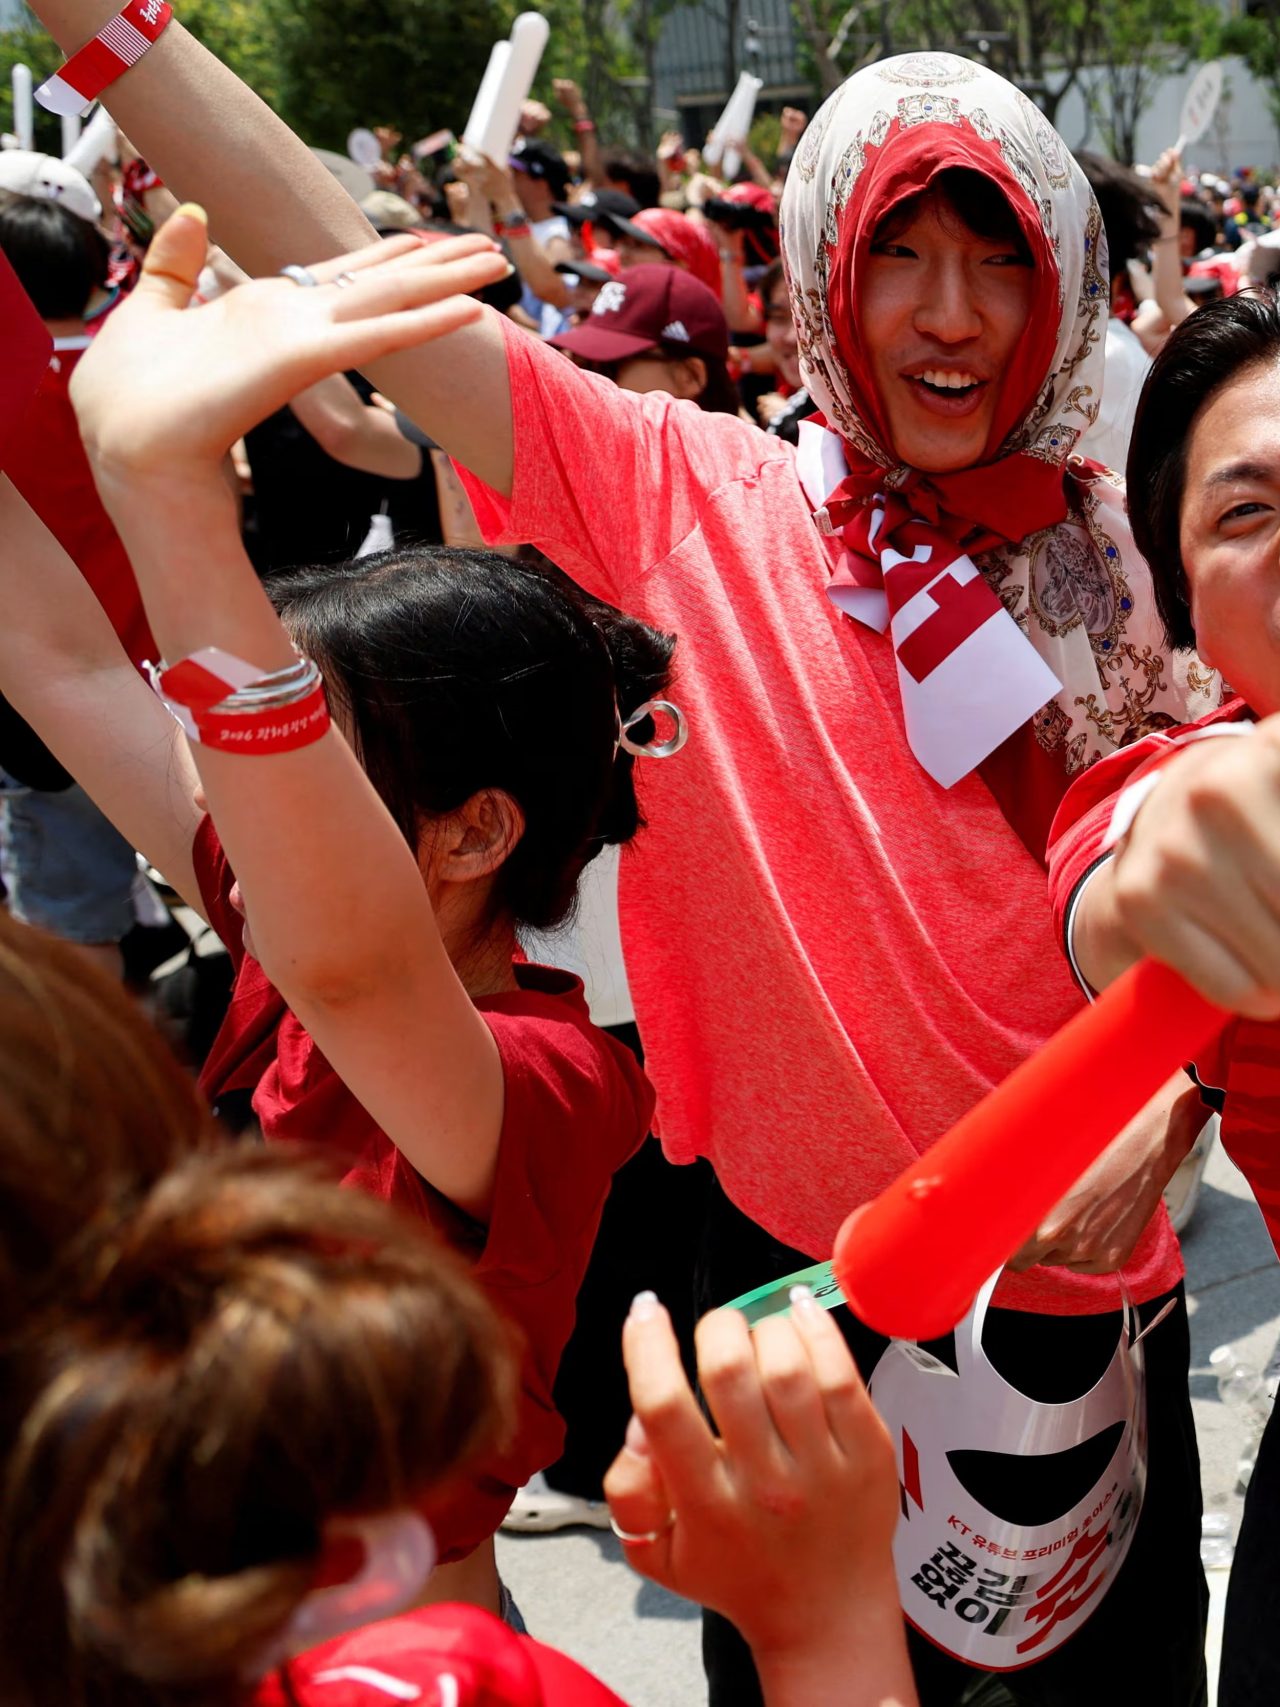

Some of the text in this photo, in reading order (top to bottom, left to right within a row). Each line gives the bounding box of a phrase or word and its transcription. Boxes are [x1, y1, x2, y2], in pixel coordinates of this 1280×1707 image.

[947, 1514, 973, 1536] KT
[971, 1531, 1017, 1561] 유튜브
[1021, 1528, 1078, 1561] 프리미엄
[910, 1562, 1011, 1636] 없이
